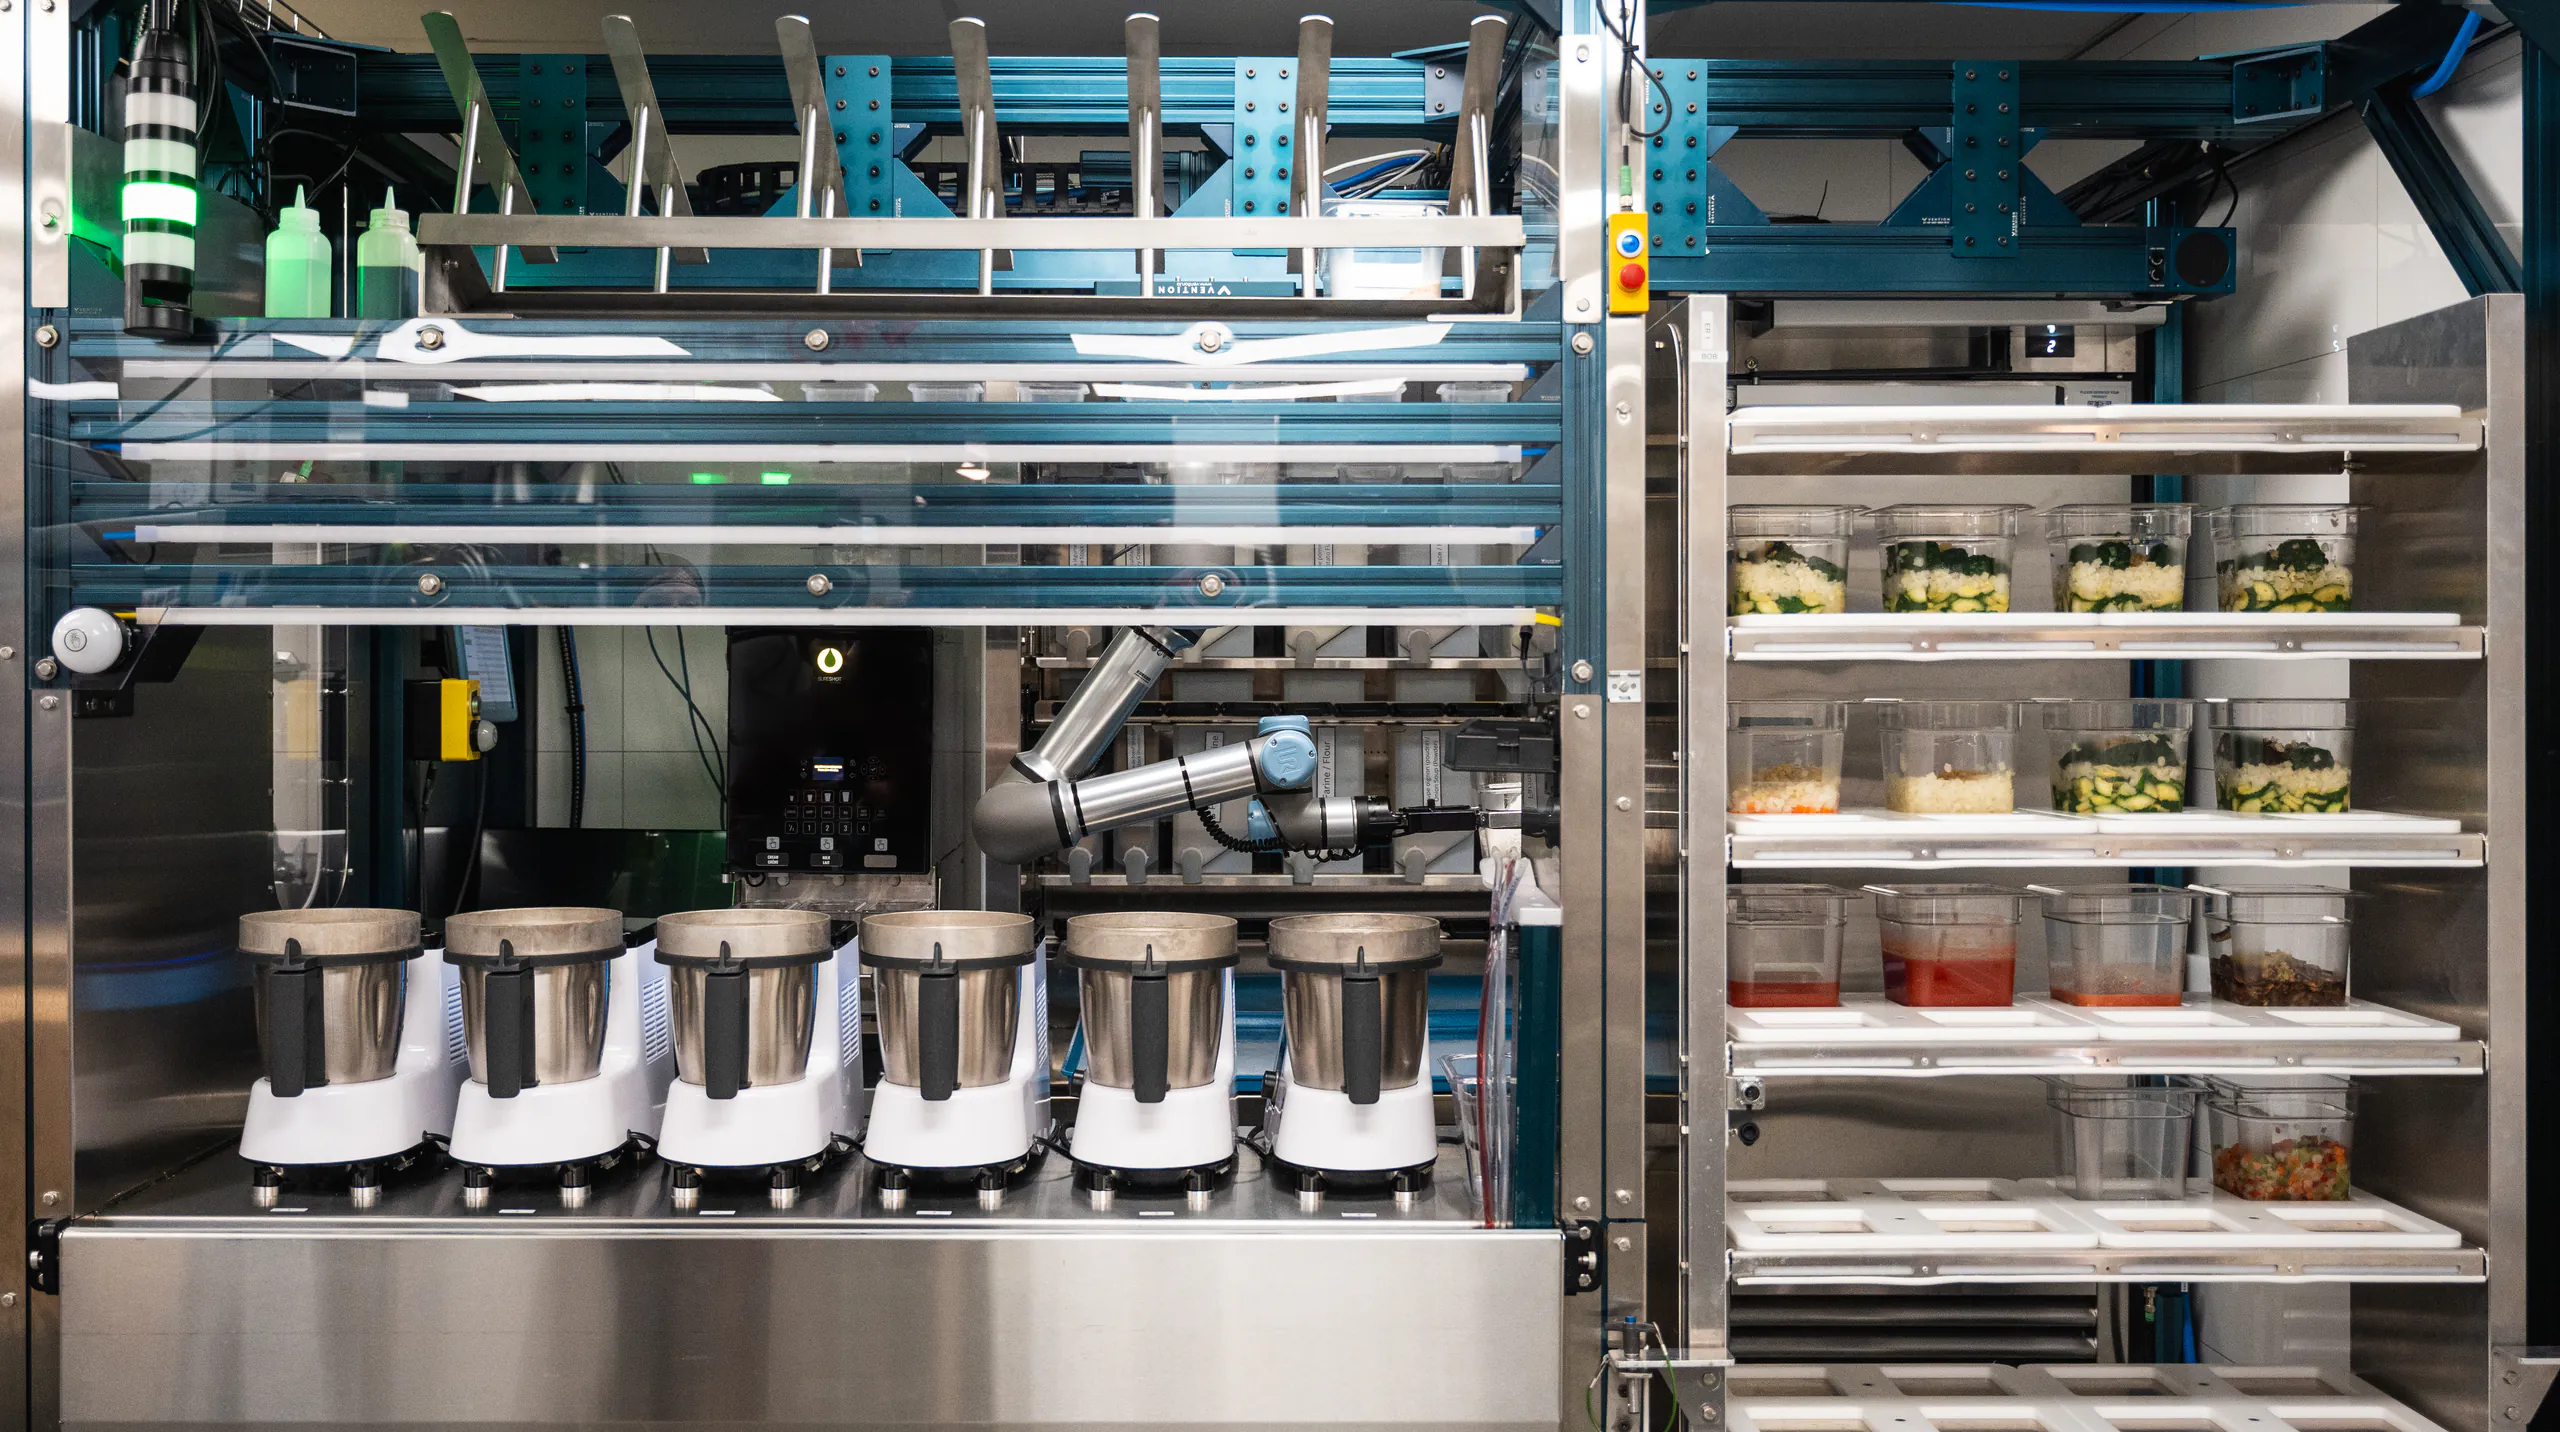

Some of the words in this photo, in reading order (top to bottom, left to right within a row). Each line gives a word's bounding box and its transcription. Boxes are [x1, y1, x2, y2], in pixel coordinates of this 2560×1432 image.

[1158, 285, 1215, 294] VENTION
[2046, 339, 2056, 354] 2
[1322, 740, 1331, 764] Flour
